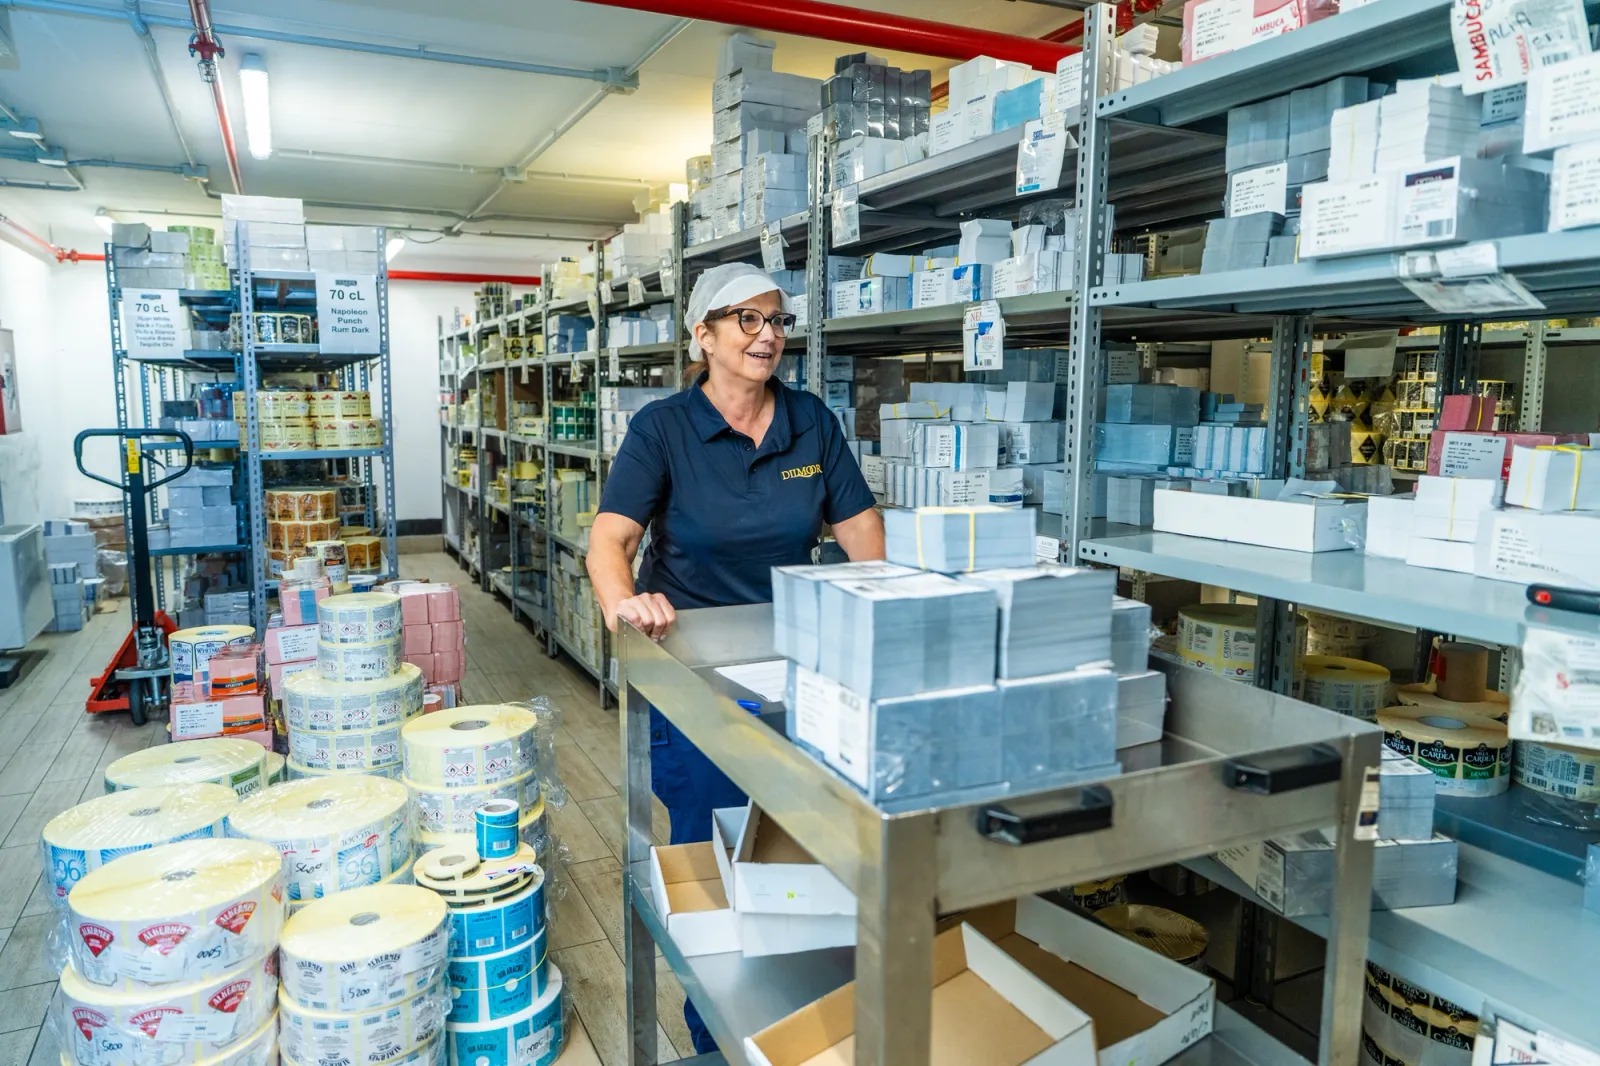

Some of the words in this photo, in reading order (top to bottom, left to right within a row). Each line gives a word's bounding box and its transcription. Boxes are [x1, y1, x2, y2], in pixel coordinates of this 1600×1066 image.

[329, 289, 345, 300] 70
[135, 303, 150, 312] 70
[1385, 738, 1412, 754] CARDEA
[1431, 746, 1447, 754] VILLA
[1420, 748, 1456, 762] CARDEA
[1465, 753, 1495, 763] CARDEA
[345, 853, 373, 882] 96
[1433, 1032, 1471, 1051] CARDEA
